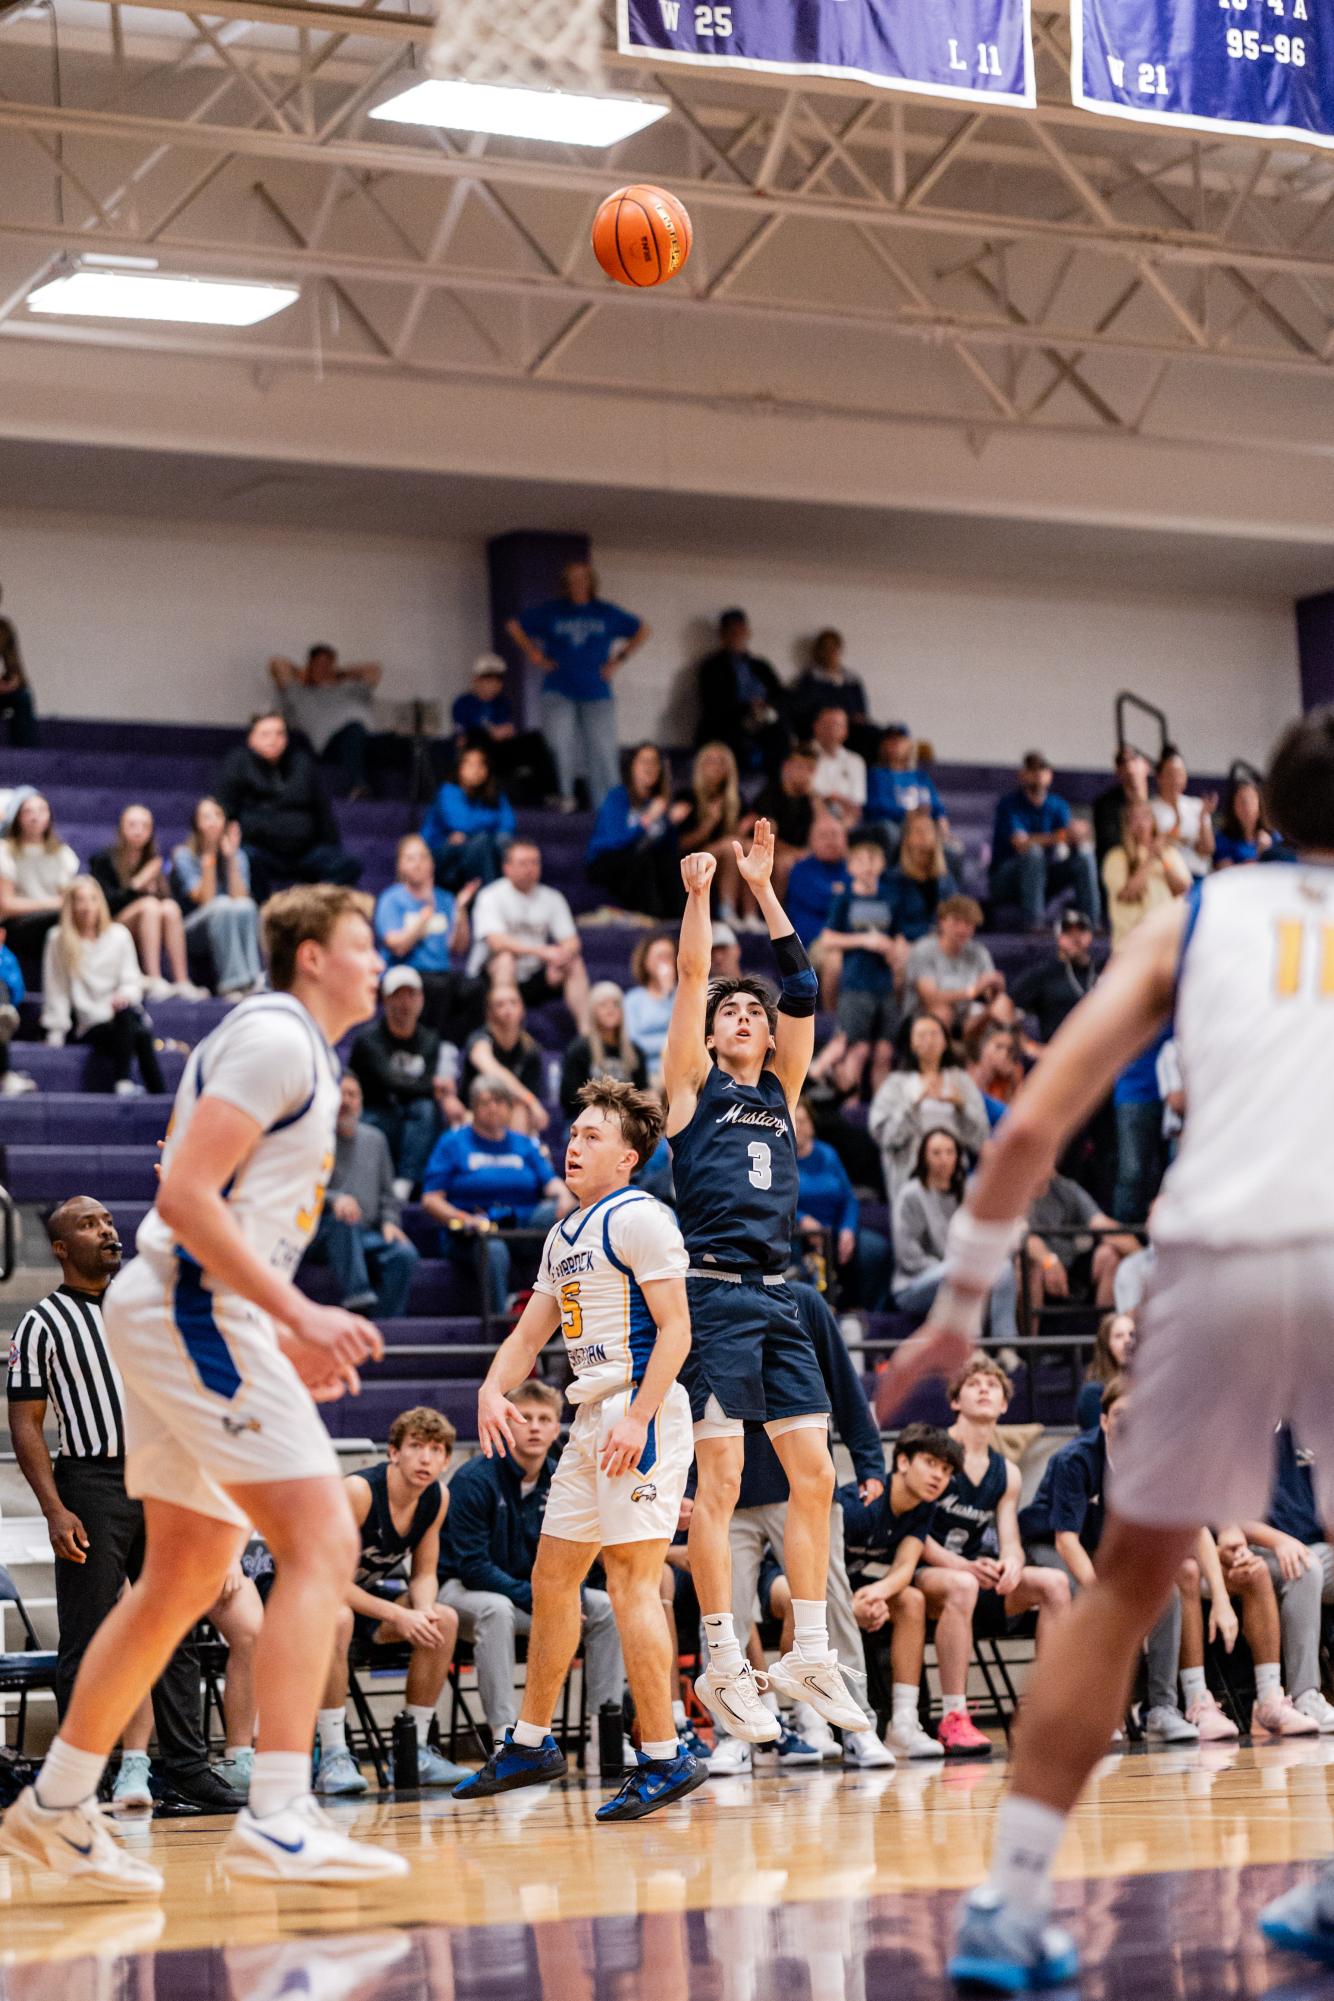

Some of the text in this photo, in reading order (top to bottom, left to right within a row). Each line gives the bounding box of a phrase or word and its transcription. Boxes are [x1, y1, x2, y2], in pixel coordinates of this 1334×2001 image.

[660, 0, 733, 37] W 25
[947, 39, 1003, 76] L 11
[1226, 28, 1306, 67] 95-96
[1138, 62, 1169, 95] 21
[748, 1141, 772, 1191] 3
[561, 1281, 583, 1339] 5
